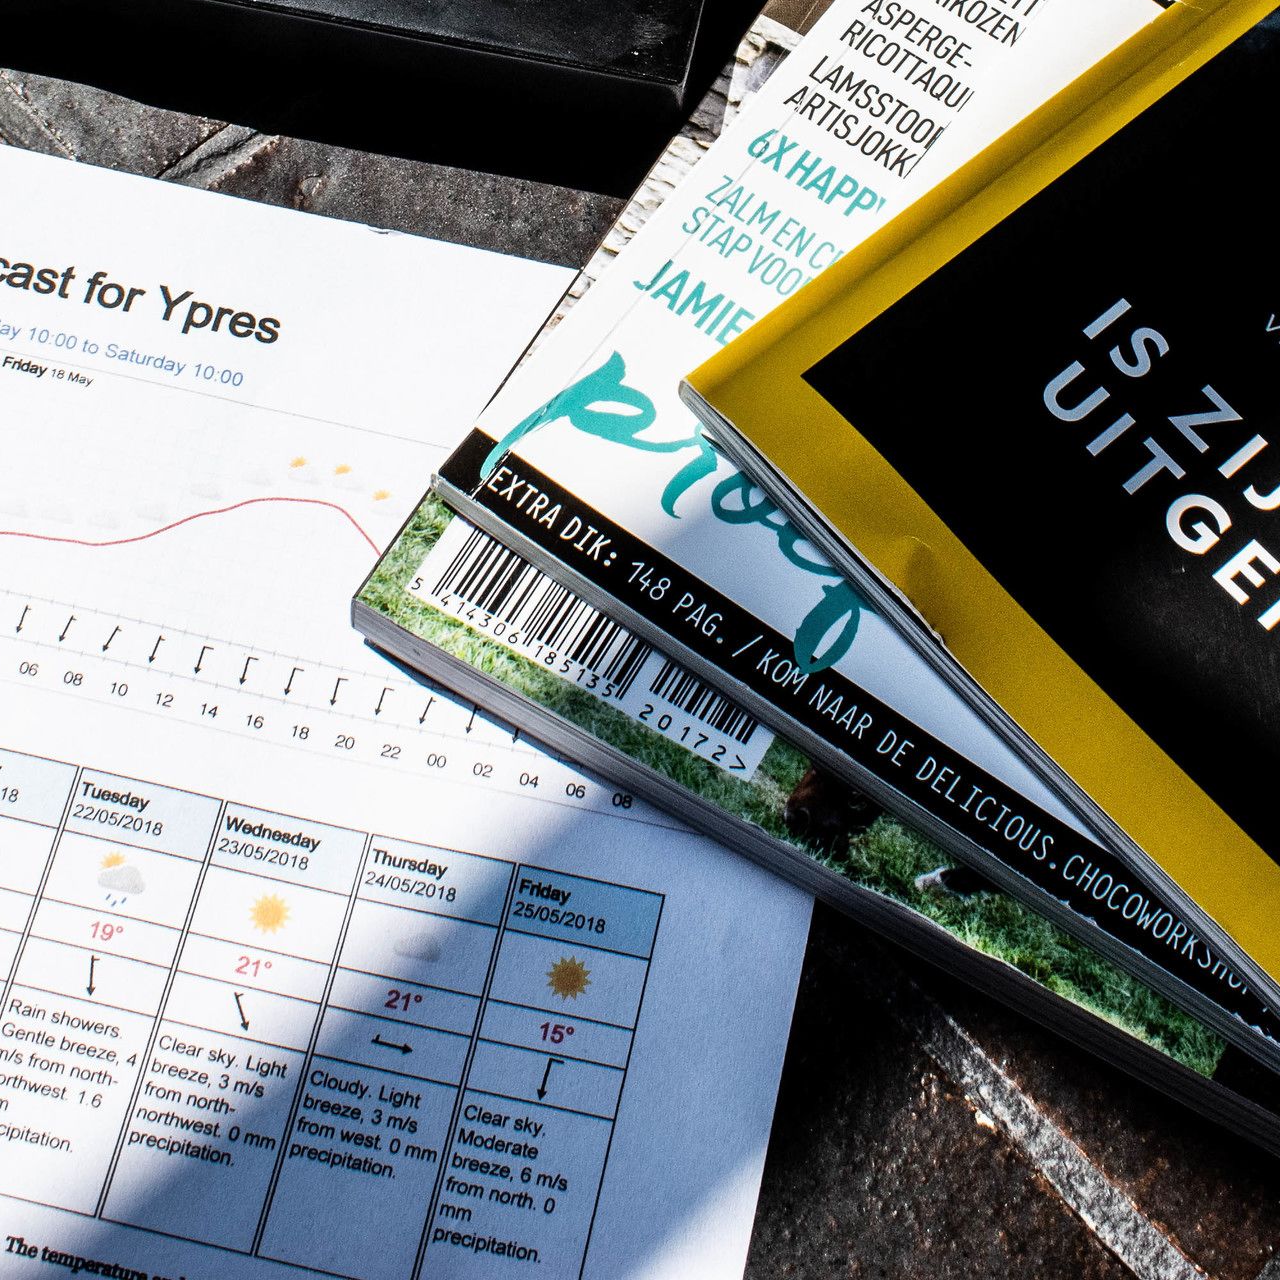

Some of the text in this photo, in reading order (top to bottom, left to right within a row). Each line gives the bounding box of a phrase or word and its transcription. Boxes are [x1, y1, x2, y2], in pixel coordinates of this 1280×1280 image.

[747, 129, 799, 172] 6X
[681, 206, 753, 258] STAP
[705, 174, 816, 258] ZALM EN
[83, 271, 147, 312] for
[159, 284, 281, 344] Ypres
[633, 259, 756, 346] JAMIE
[1081, 297, 1172, 379] IS
[1, 356, 94, 388] Friday 18 May
[30, 327, 78, 350] 10:00
[82, 339, 99, 355] to
[105, 343, 187, 376] Saturday
[195, 363, 244, 387] 10:00
[487, 466, 565, 530] EXTRA
[560, 515, 618, 568] DIK:
[629, 561, 672, 601] 148
[672, 592, 724, 645] PAG.
[756, 648, 810, 696] KOM
[808, 684, 873, 740] NAAR
[876, 730, 915, 767] DE
[83, 781, 151, 813] Tuesday
[72, 804, 163, 837] 22/05/2018
[226, 815, 322, 853] Wednesday
[218, 838, 309, 871] 23/05/2018
[373, 848, 448, 881] Thursday
[364, 871, 456, 903] 24/05/2018
[518, 878, 572, 907] Friday
[512, 902, 606, 935] 25/05/2018
[464, 1105, 546, 1139] Clear sky,
[457, 1128, 539, 1161] Moderate
[451, 1152, 568, 1193] breeze, 6 m/s
[439, 1204, 472, 1223] mm
[446, 1176, 555, 1216] from north. 0
[432, 1228, 541, 1264] precipitation.
